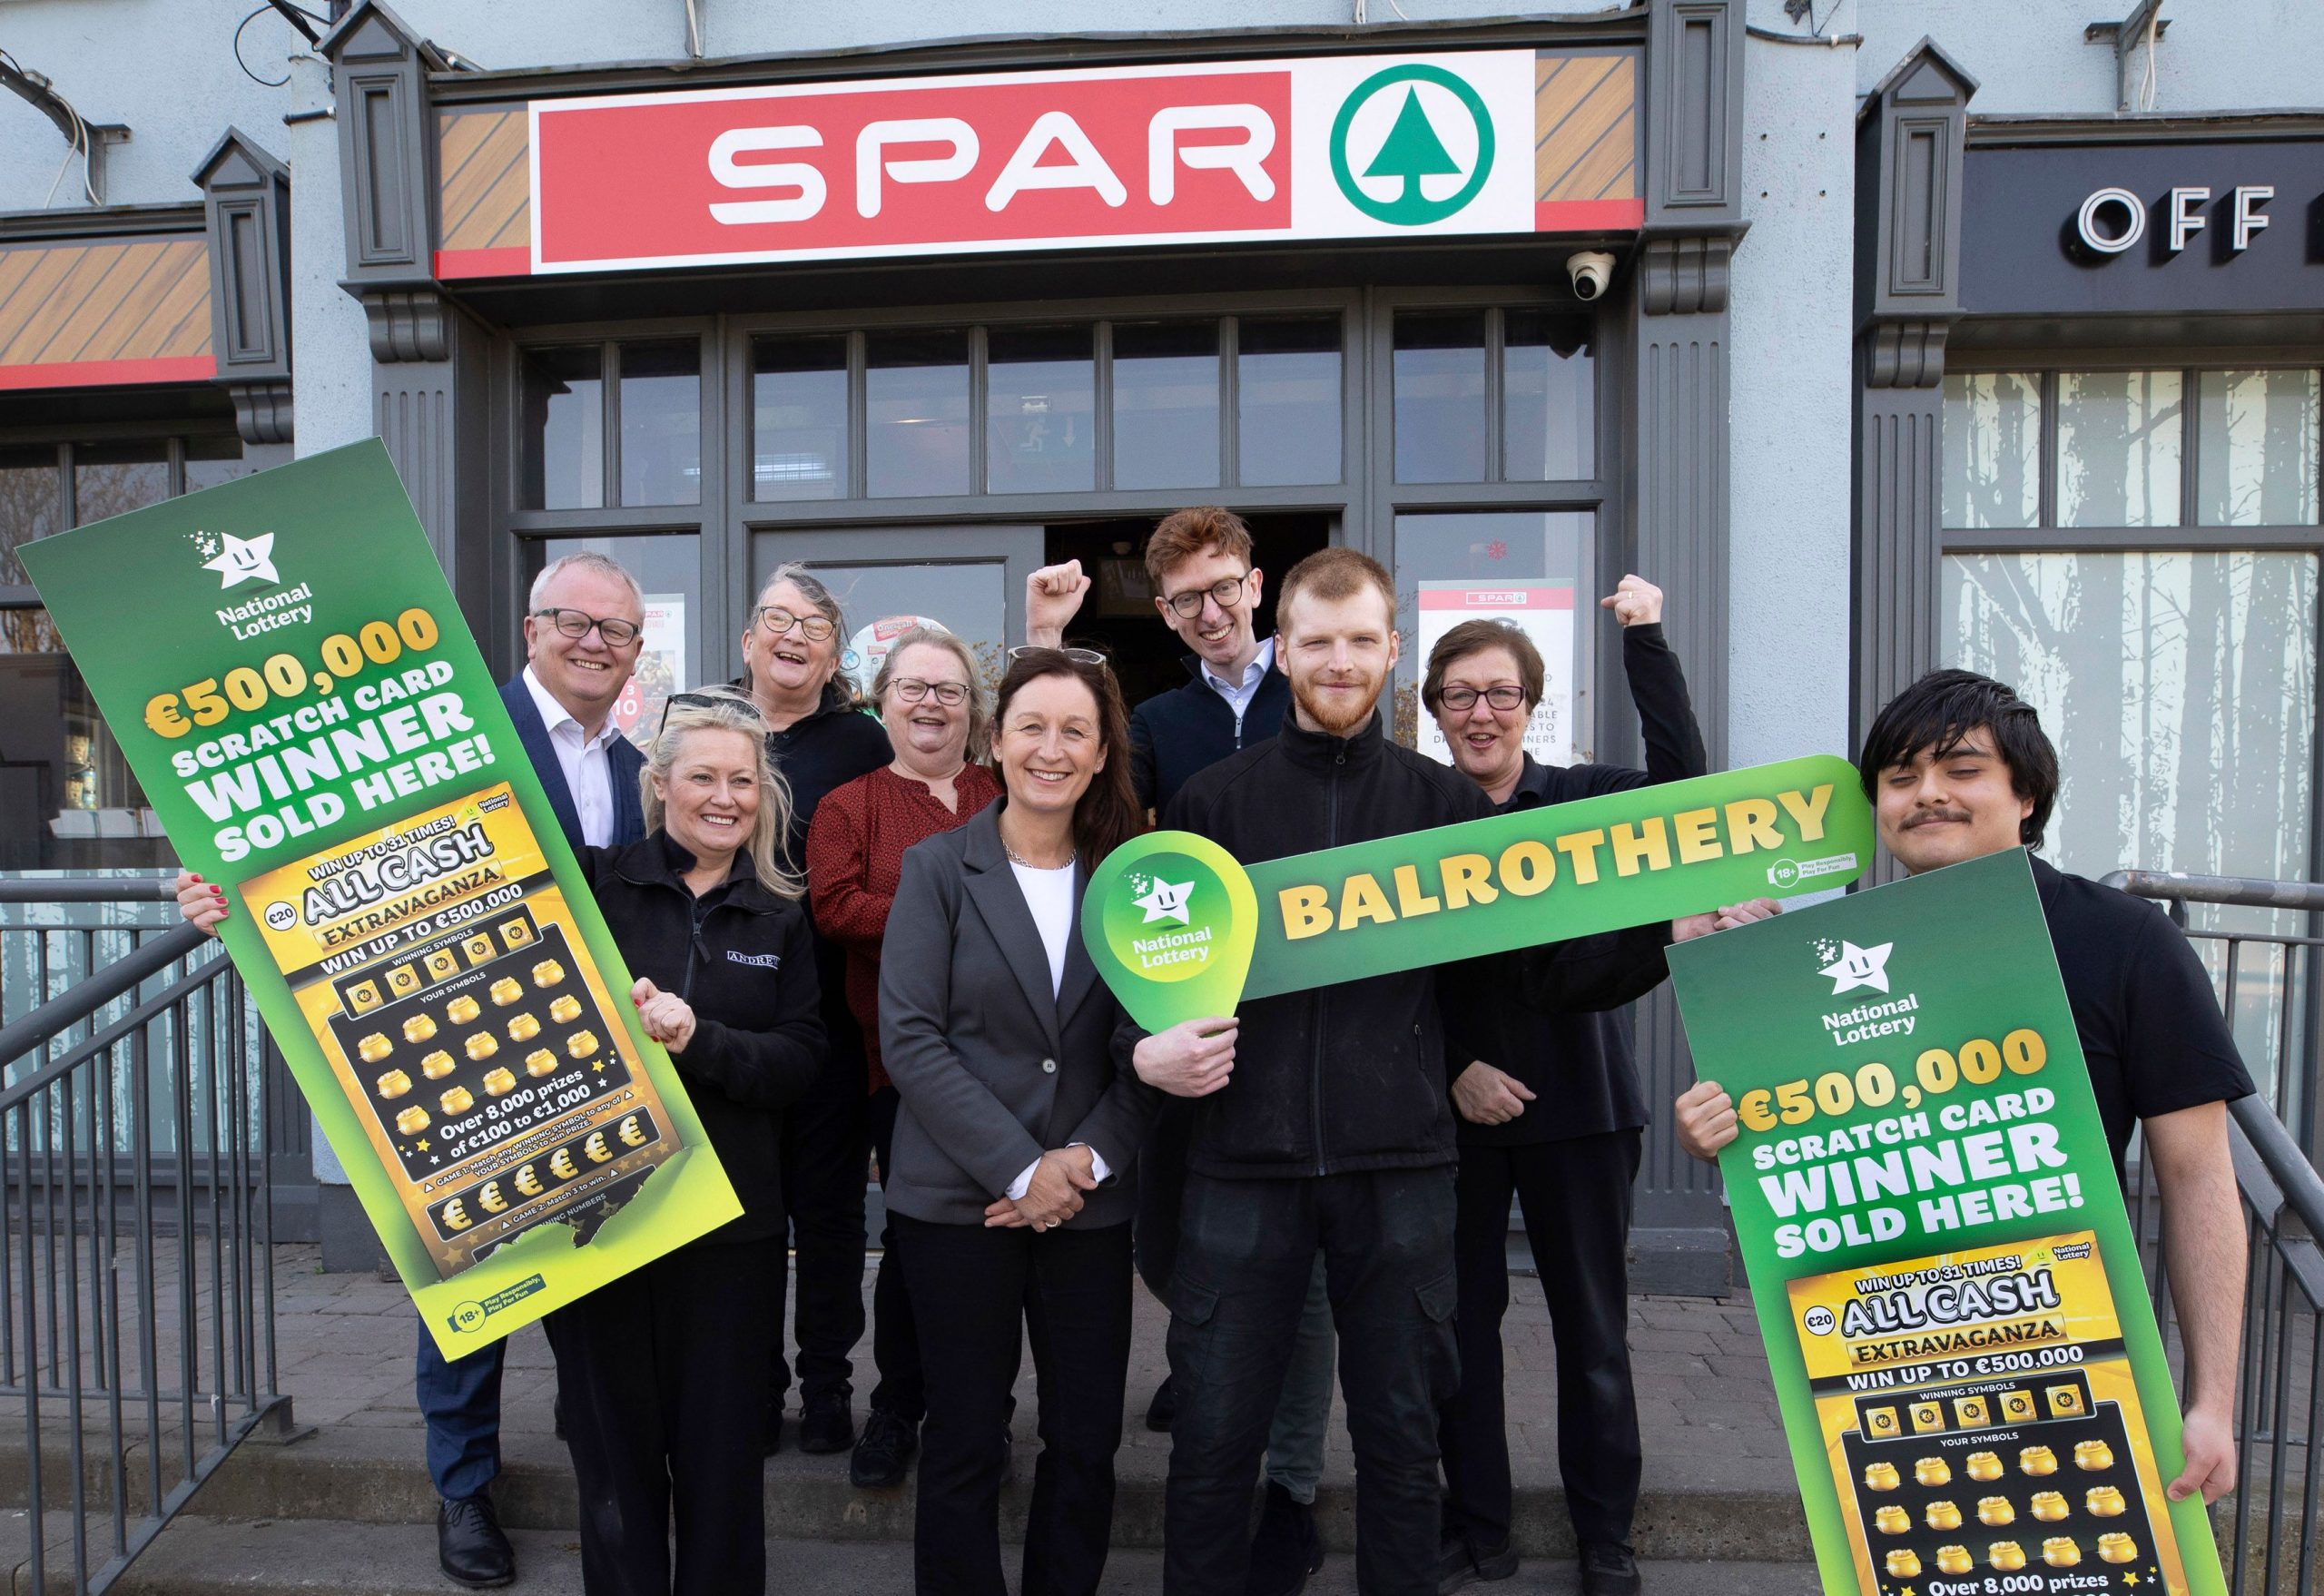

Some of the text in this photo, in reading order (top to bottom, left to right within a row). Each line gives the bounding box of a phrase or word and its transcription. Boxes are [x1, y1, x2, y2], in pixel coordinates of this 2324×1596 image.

[707, 103, 1277, 226] SPAR
[2078, 186, 2274, 252] OFF
[216, 582, 312, 626] National
[231, 603, 312, 641] Lottery
[144, 607, 438, 738] €500,000
[171, 660, 454, 778] SCRATCH CARD
[183, 692, 474, 823] WINNER
[213, 734, 496, 862] SOLD HERE!
[478, 793, 508, 808] National
[484, 800, 508, 813] Lottery
[309, 814, 456, 881] WIN UP TO 31 TIMES!
[1278, 783, 1834, 940] BALROTHERY
[303, 823, 493, 925] ALL CASH
[1777, 868, 1797, 879] 18+
[268, 909, 293, 924] €20
[323, 868, 498, 945] EXTRAVAGANZA
[320, 884, 523, 976] WIN UP TO €500,000
[392, 929, 474, 967] WINNING SYMBOLS
[1133, 926, 1212, 954] National
[1140, 945, 1209, 969] Lottery
[420, 971, 486, 1003] YOUR SYMBOLS
[1821, 993, 1919, 1031] National
[1833, 1015, 1915, 1047] Lottery
[1738, 1028, 2047, 1132] €500,000
[440, 1070, 583, 1139] Over 8,000 prizes
[450, 1084, 591, 1158] of €100 to €1,000
[436, 1171, 463, 1187] GAME
[470, 1155, 496, 1170] Match
[497, 1148, 512, 1159] any
[513, 1129, 552, 1150] WINNING
[551, 1114, 586, 1132] SYMBOL
[586, 1108, 596, 1117] to
[596, 1102, 611, 1114] any
[610, 1096, 621, 1106] of
[475, 1120, 592, 1177] YOUR SYMBOLS to win PRIZE.
[1752, 1087, 2055, 1170] SCRATCH CARD
[1758, 1122, 2068, 1218] WINNER
[512, 1207, 536, 1223] GAME
[546, 1190, 572, 1207] Match
[571, 1187, 578, 1195] 3
[578, 1182, 587, 1191] to
[588, 1175, 606, 1187] win.
[566, 1193, 606, 1217] NUMBERS
[1773, 1172, 2084, 1259] SOLD HERE!
[2053, 1243, 2090, 1254] National
[2058, 1251, 2089, 1260] Lottery
[1856, 1255, 2022, 1294] WIN UP TO 31 TIMES!
[459, 1309, 481, 1325] 18+
[484, 1296, 500, 1307] Play
[487, 1289, 529, 1314] Play For Fun
[1807, 1314, 1832, 1327] €20
[1842, 1269, 2060, 1337] ALL CASH
[1856, 1320, 2060, 1364] EXTRAVAGANZA
[1847, 1345, 2083, 1391] WIN UP TO €500,000
[1920, 1382, 2015, 1401] WINNING SYMBOLS
[1940, 1432, 2019, 1447] YOUR SYMBOLS
[1929, 1573, 2108, 1596] Over 8,000 prizes
